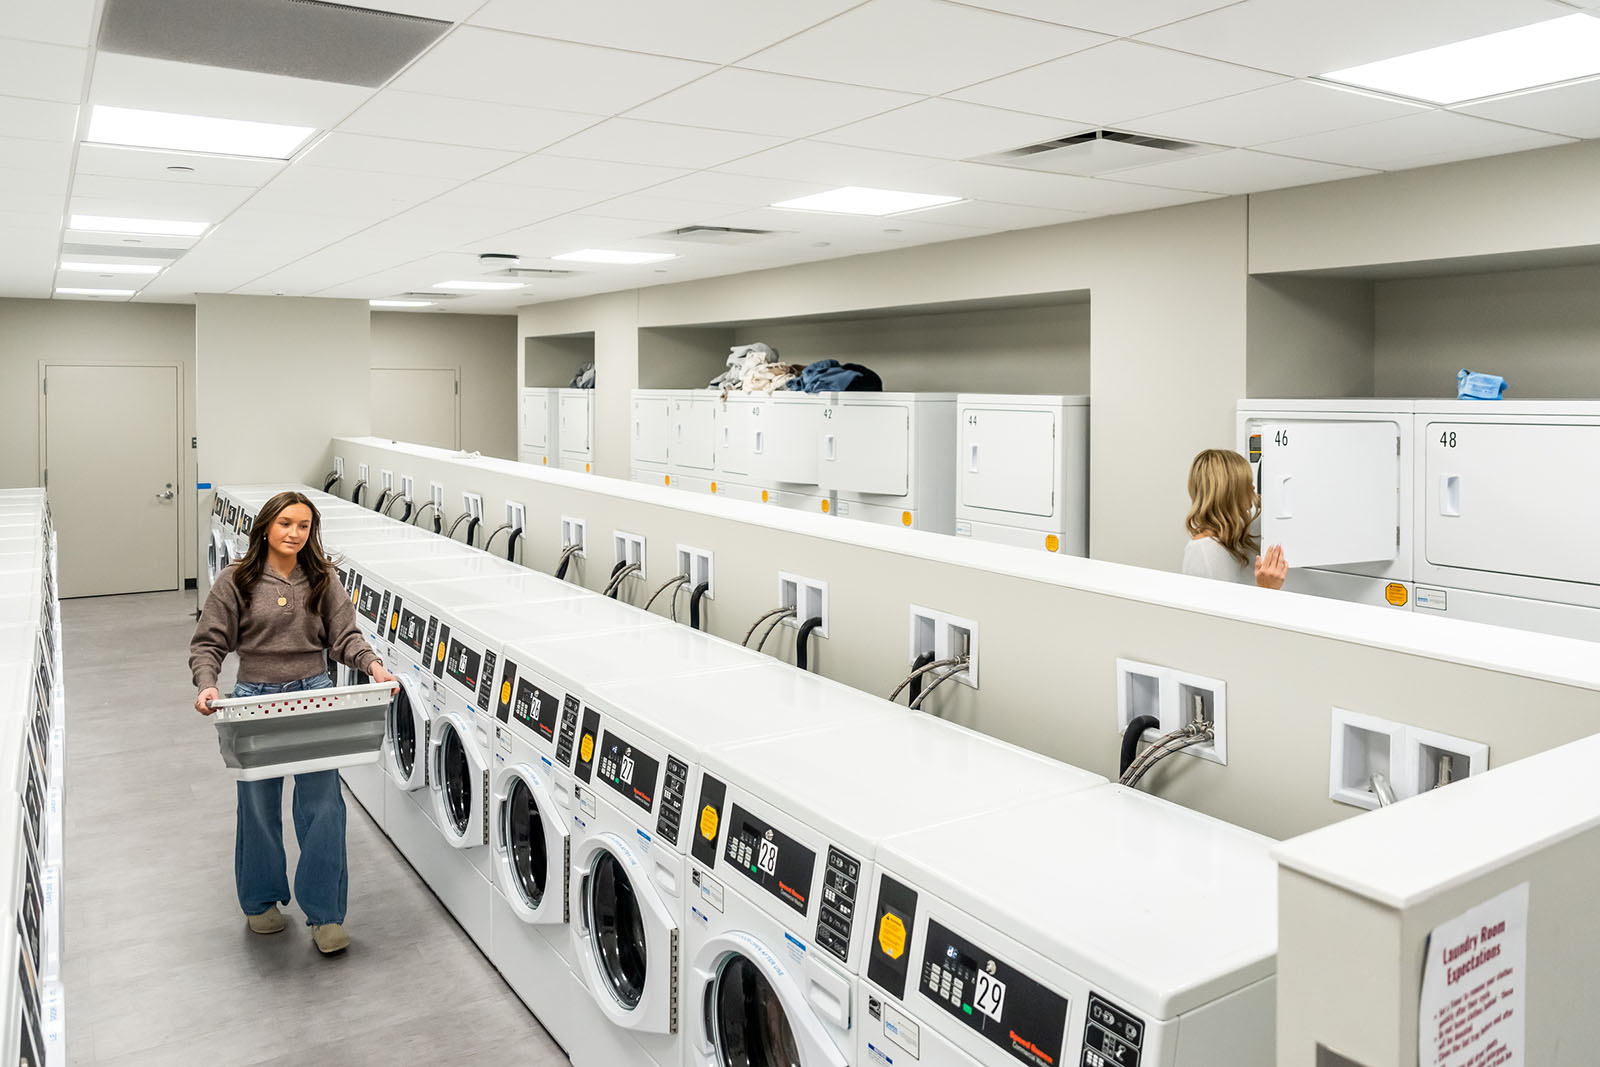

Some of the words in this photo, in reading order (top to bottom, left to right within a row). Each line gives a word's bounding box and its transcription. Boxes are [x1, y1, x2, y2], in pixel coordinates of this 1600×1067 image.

[823, 408, 833, 419] 42
[968, 415, 977, 426] 44
[1274, 429, 1288, 446] 46
[1439, 431, 1456, 448] 48
[621, 758, 634, 780] 27
[760, 842, 776, 872] 28
[1443, 934, 1478, 965] Laundry
[1480, 920, 1505, 943] Room
[1447, 943, 1501, 986] Expectations
[976, 976, 1002, 1014] 29
